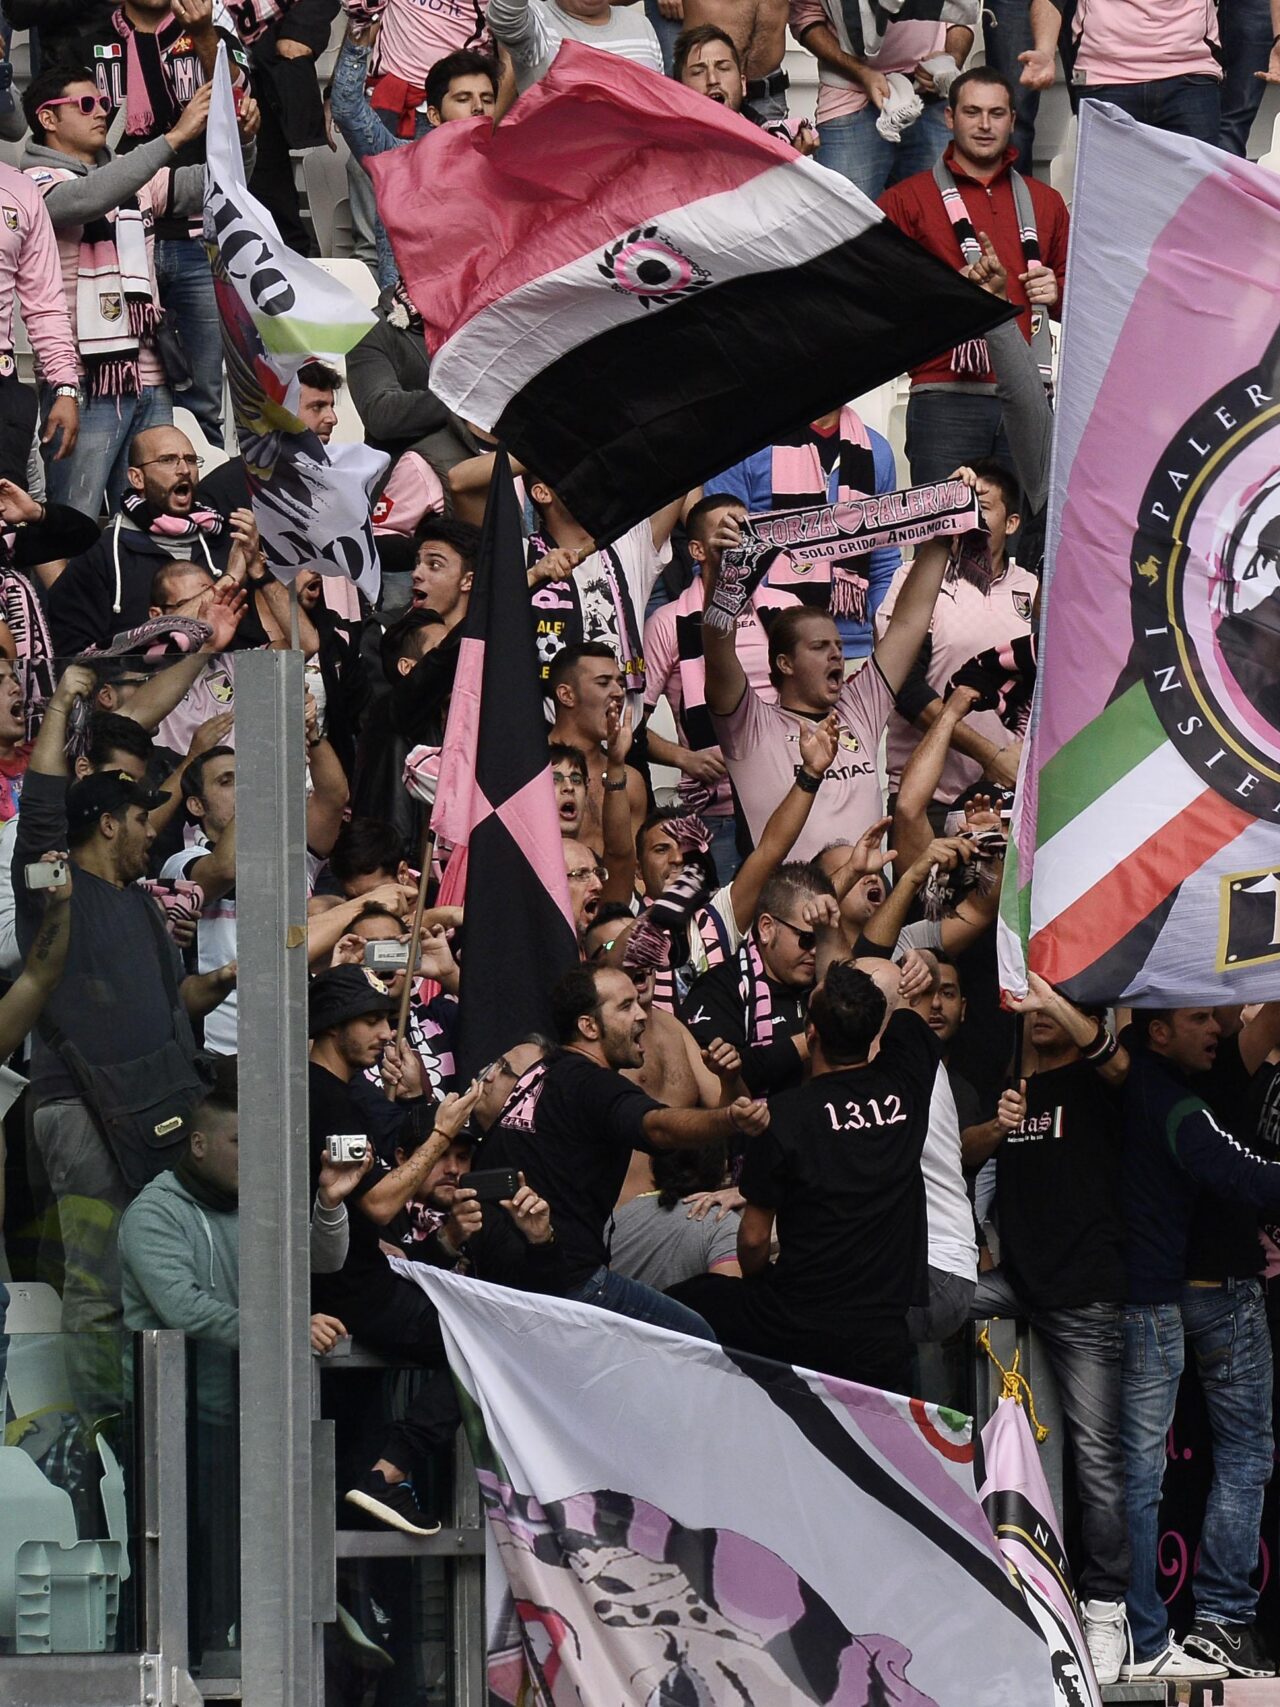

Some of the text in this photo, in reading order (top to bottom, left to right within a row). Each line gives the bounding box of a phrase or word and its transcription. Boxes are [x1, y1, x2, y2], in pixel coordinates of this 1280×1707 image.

[756, 479, 972, 546] FORZA PALERMO
[799, 546, 835, 561] SOLO
